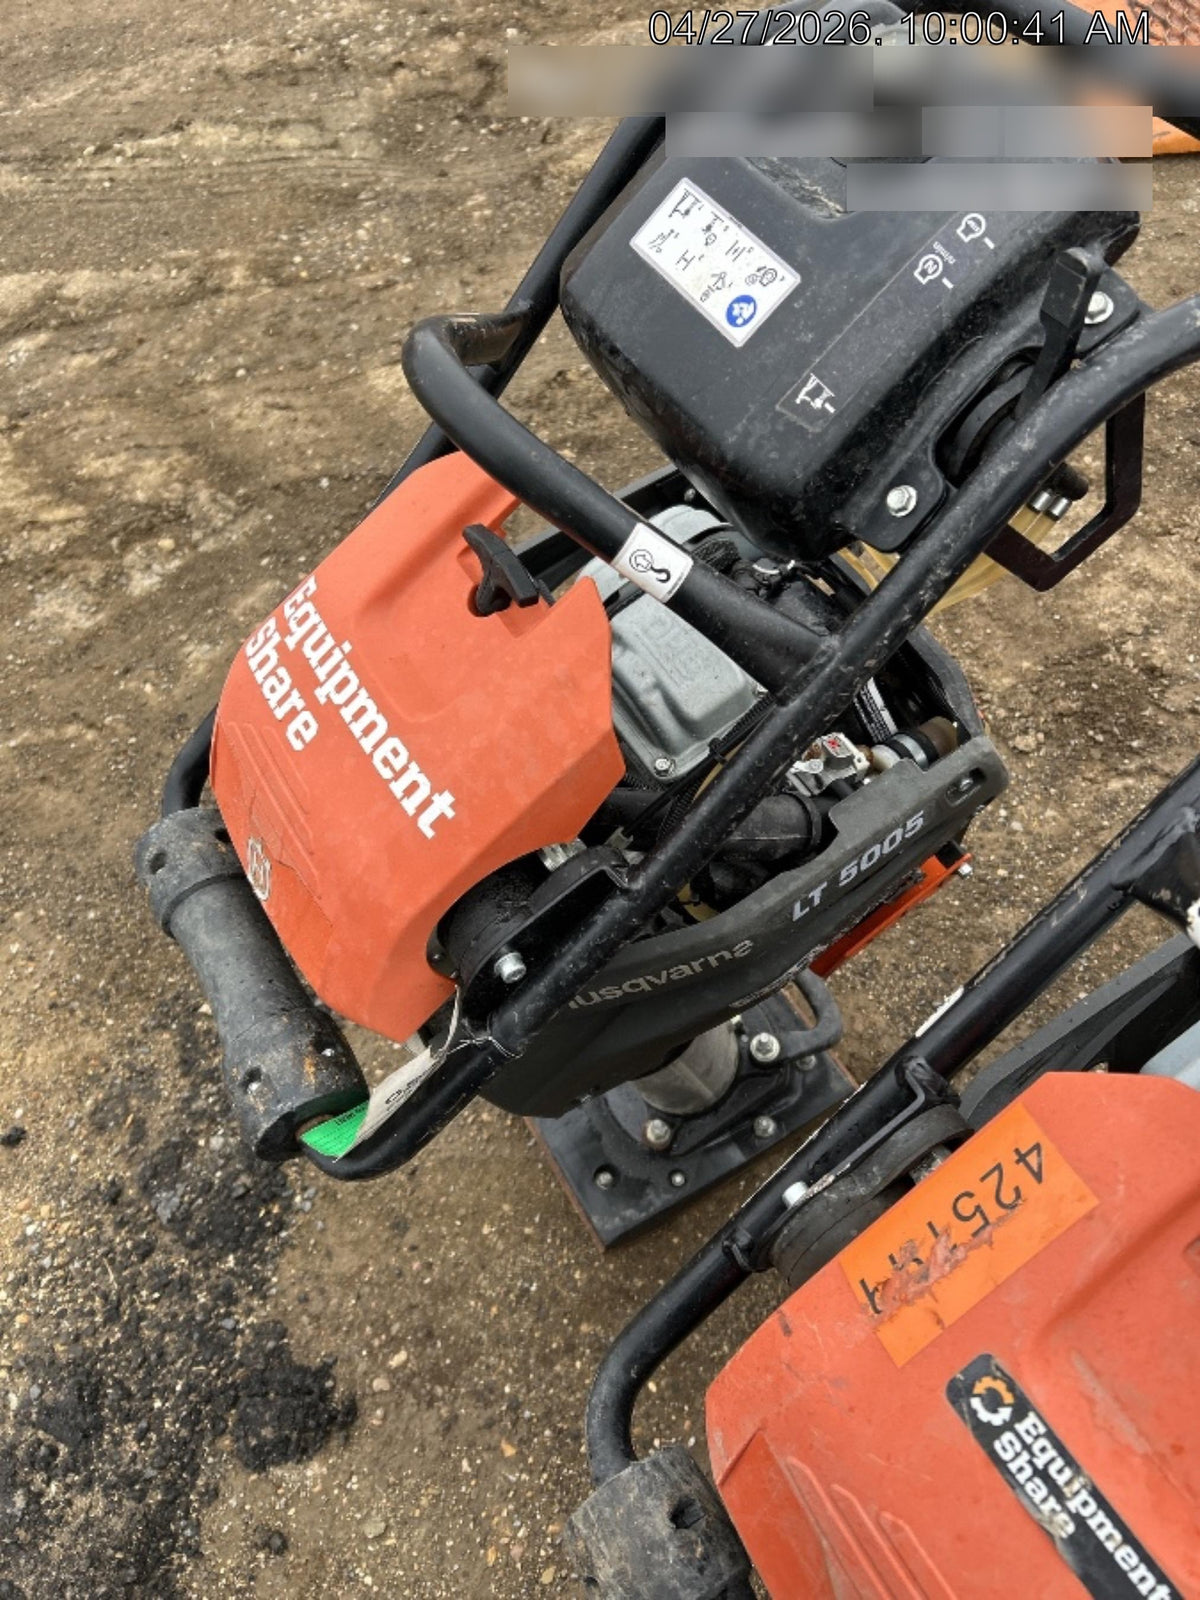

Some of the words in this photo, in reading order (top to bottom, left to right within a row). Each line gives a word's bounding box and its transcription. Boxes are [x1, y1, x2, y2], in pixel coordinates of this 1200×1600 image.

[283, 575, 456, 839] Equipment
[792, 882, 828, 921] LT
[838, 810, 925, 886] 5005
